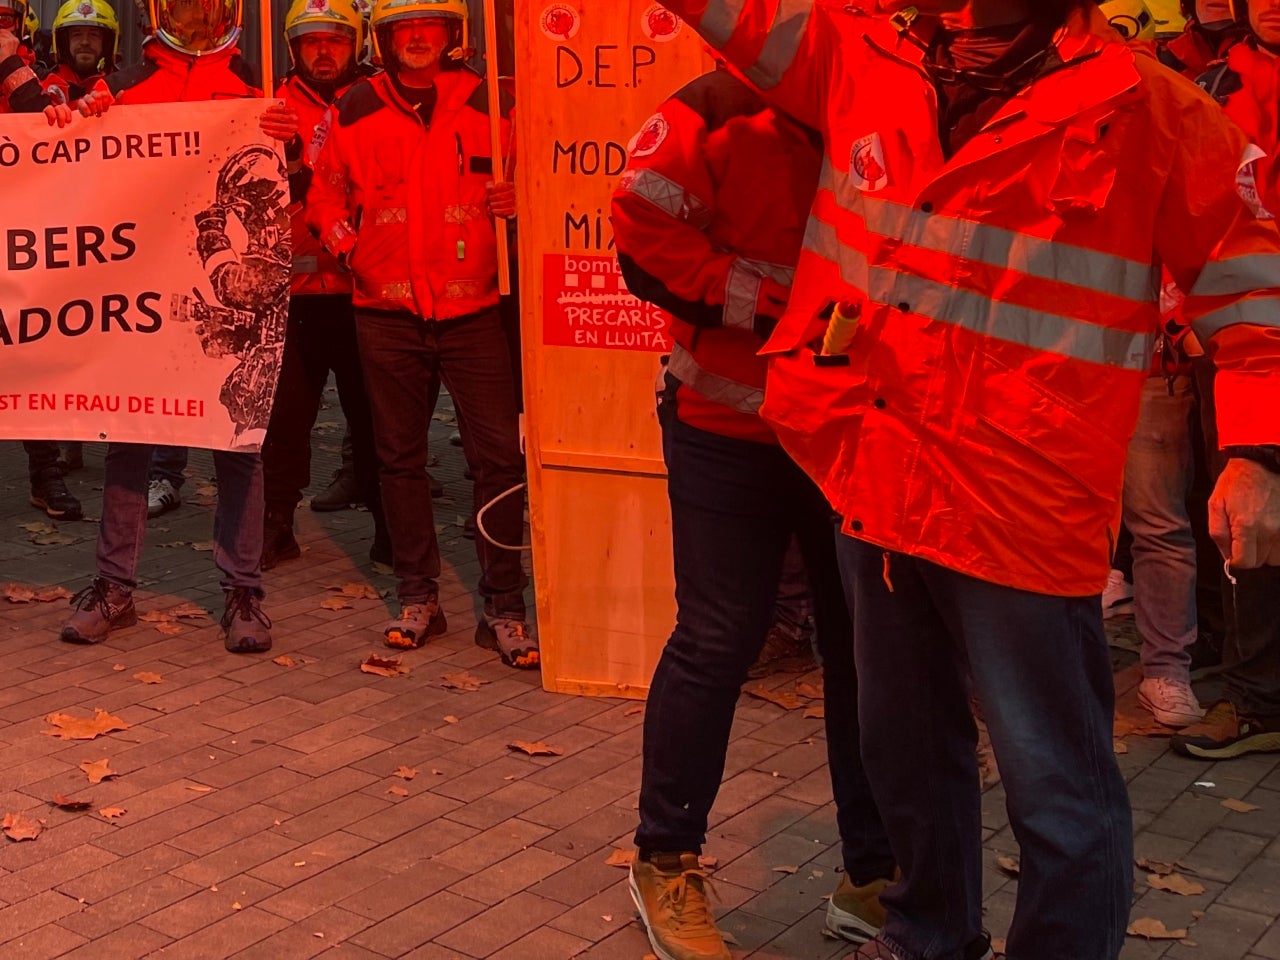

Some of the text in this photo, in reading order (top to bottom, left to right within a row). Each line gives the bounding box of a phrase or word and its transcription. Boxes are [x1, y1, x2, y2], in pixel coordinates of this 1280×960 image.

[31, 138, 91, 164] CAP
[101, 131, 201, 160] DRET!!
[575, 329, 597, 344] EN
[28, 394, 56, 410] EN
[64, 394, 120, 412] FRAU
[128, 396, 154, 414] DE
[161, 398, 205, 417] LLEI
